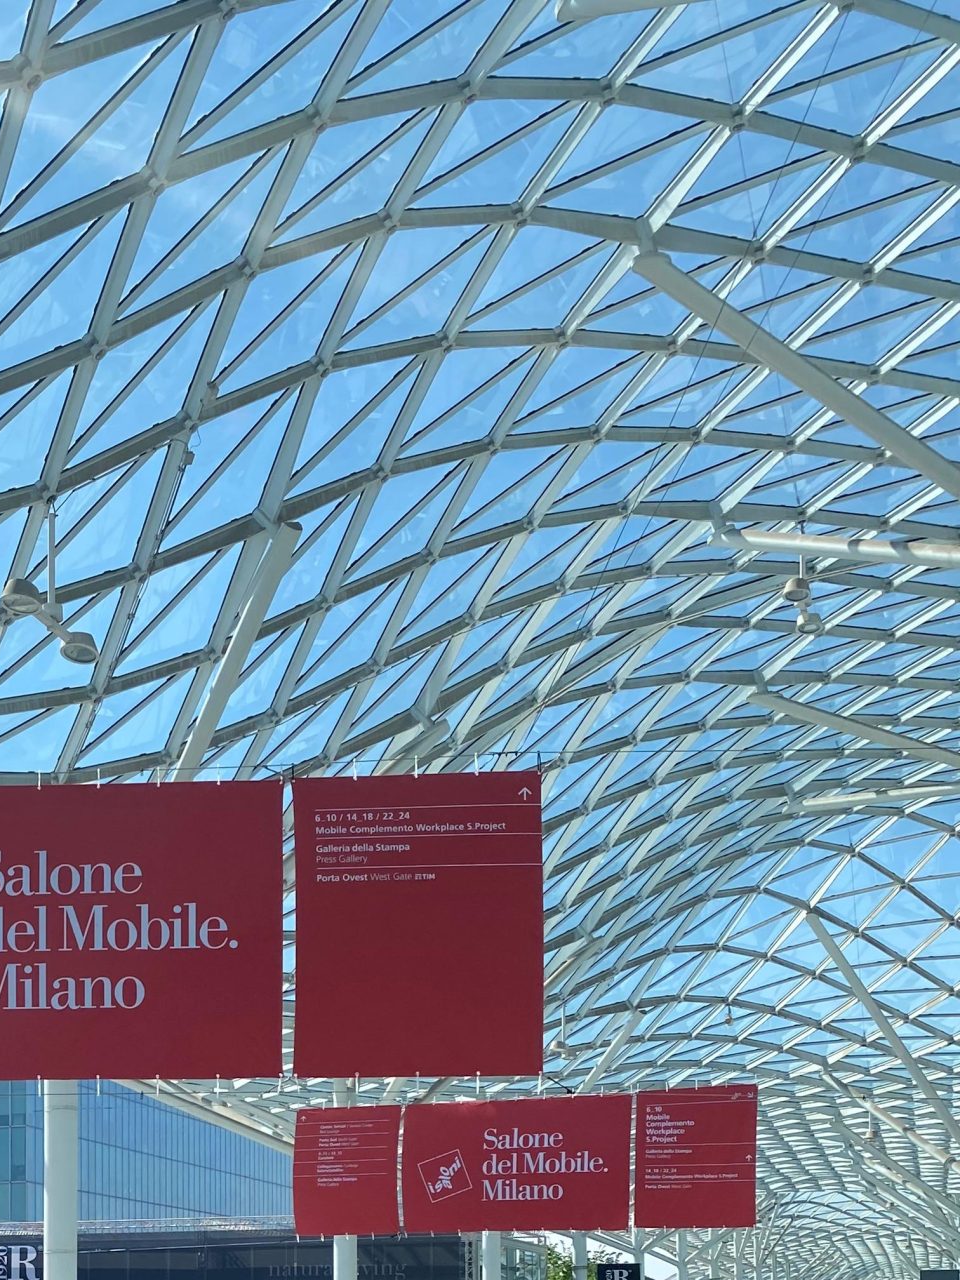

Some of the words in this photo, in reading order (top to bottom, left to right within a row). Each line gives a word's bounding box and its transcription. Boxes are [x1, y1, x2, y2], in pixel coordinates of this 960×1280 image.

[315, 825, 347, 834] Mobile
[349, 824, 414, 834] Complemento
[415, 823, 464, 833] Workplace
[466, 822, 506, 832] S.Project
[316, 844, 350, 853] Galleria
[351, 844, 374, 852] della
[375, 843, 410, 853] Stampa
[316, 855, 337, 863] Press
[338, 854, 368, 864] Gallery
[316, 874, 340, 882] Porta
[342, 873, 368, 881] Ovest
[370, 873, 391, 881] West
[393, 872, 412, 881] Gate
[57, 903, 239, 951] Mobile.
[483, 1128, 563, 1149] Salone
[646, 1128, 685, 1136] Workplace
[482, 1153, 518, 1175] del
[522, 1151, 608, 1174] Mobile.
[481, 1178, 563, 1201] Milano
[269, 1260, 333, 1277] natura
